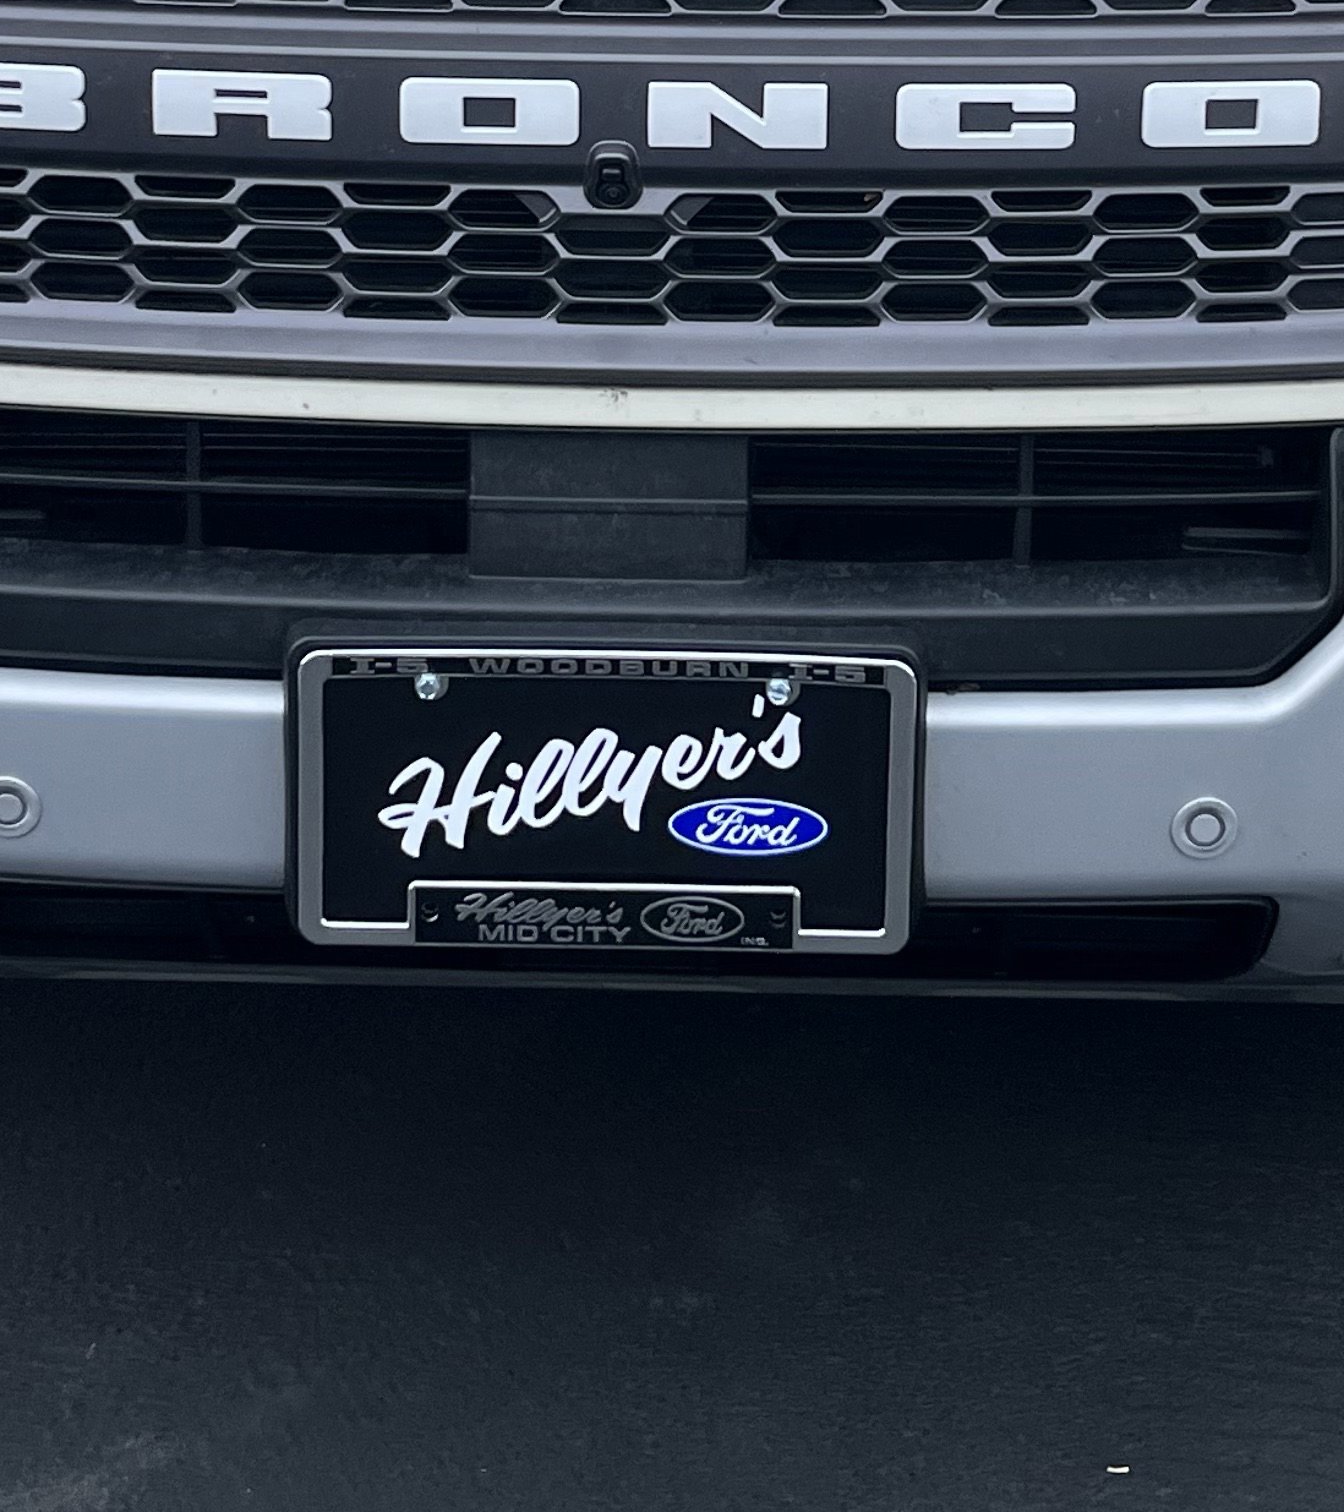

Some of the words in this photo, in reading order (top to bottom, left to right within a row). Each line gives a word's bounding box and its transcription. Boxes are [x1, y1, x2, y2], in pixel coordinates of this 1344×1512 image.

[350, 657, 429, 675] I-5
[468, 658, 749, 678] WOODBURN
[788, 662, 866, 684] I-5
[378, 693, 802, 858] Hillyer's
[690, 802, 804, 849] Ford
[455, 891, 624, 931] Hillyer's
[657, 901, 728, 937] Ford
[478, 923, 539, 942] MID
[549, 925, 631, 943] CITY
